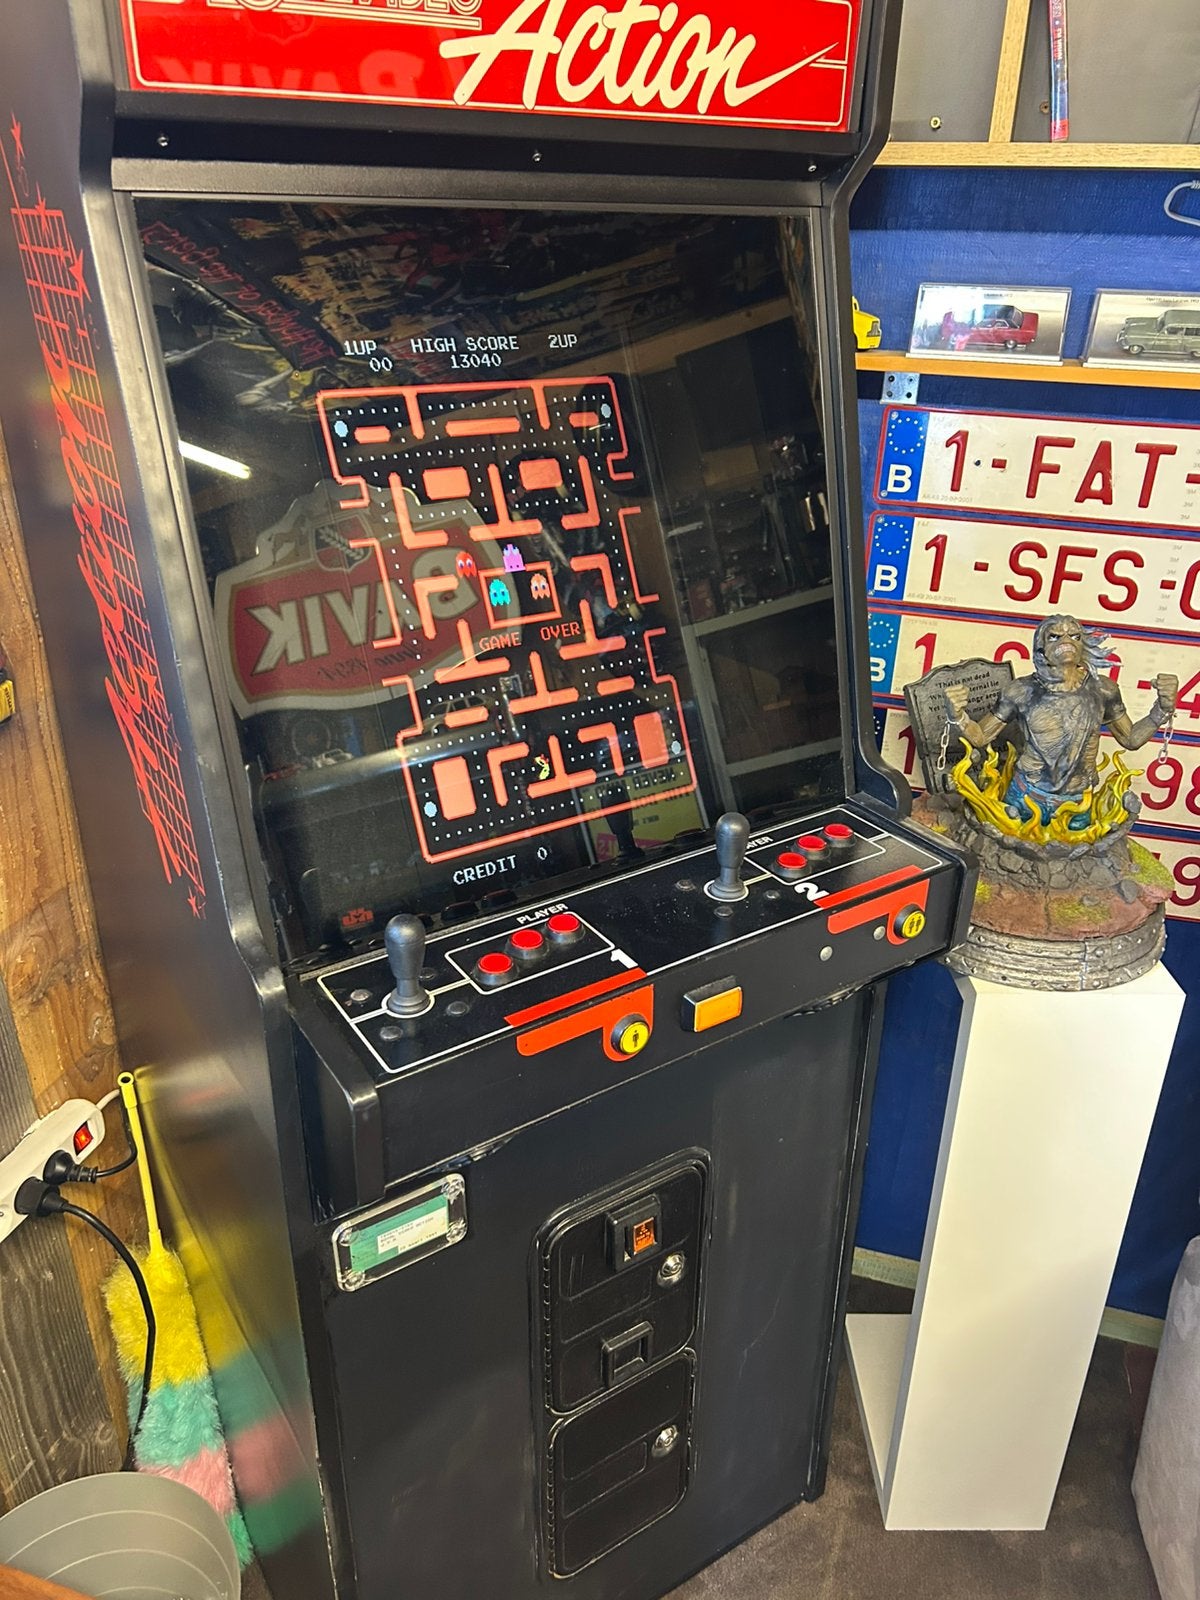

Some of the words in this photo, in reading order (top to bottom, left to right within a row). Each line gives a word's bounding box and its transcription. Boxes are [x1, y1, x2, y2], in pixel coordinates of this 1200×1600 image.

[439, 0, 839, 114] Action
[344, 340, 377, 356] 1UP
[411, 337, 457, 354] HIGH
[465, 335, 520, 351] SCORE
[548, 334, 578, 349] 2UP
[369, 357, 393, 372] 00
[450, 353, 502, 369] 13040
[887, 464, 913, 493] B
[873, 565, 899, 592] B
[479, 632, 522, 650] GAME
[539, 621, 581, 641] OVER
[974, 672, 990, 680] dead
[745, 835, 774, 850] AYER
[453, 855, 517, 885] CREDIT
[537, 847, 548, 860] 0
[794, 882, 830, 902] 2
[516, 903, 569, 925] PLAYER
